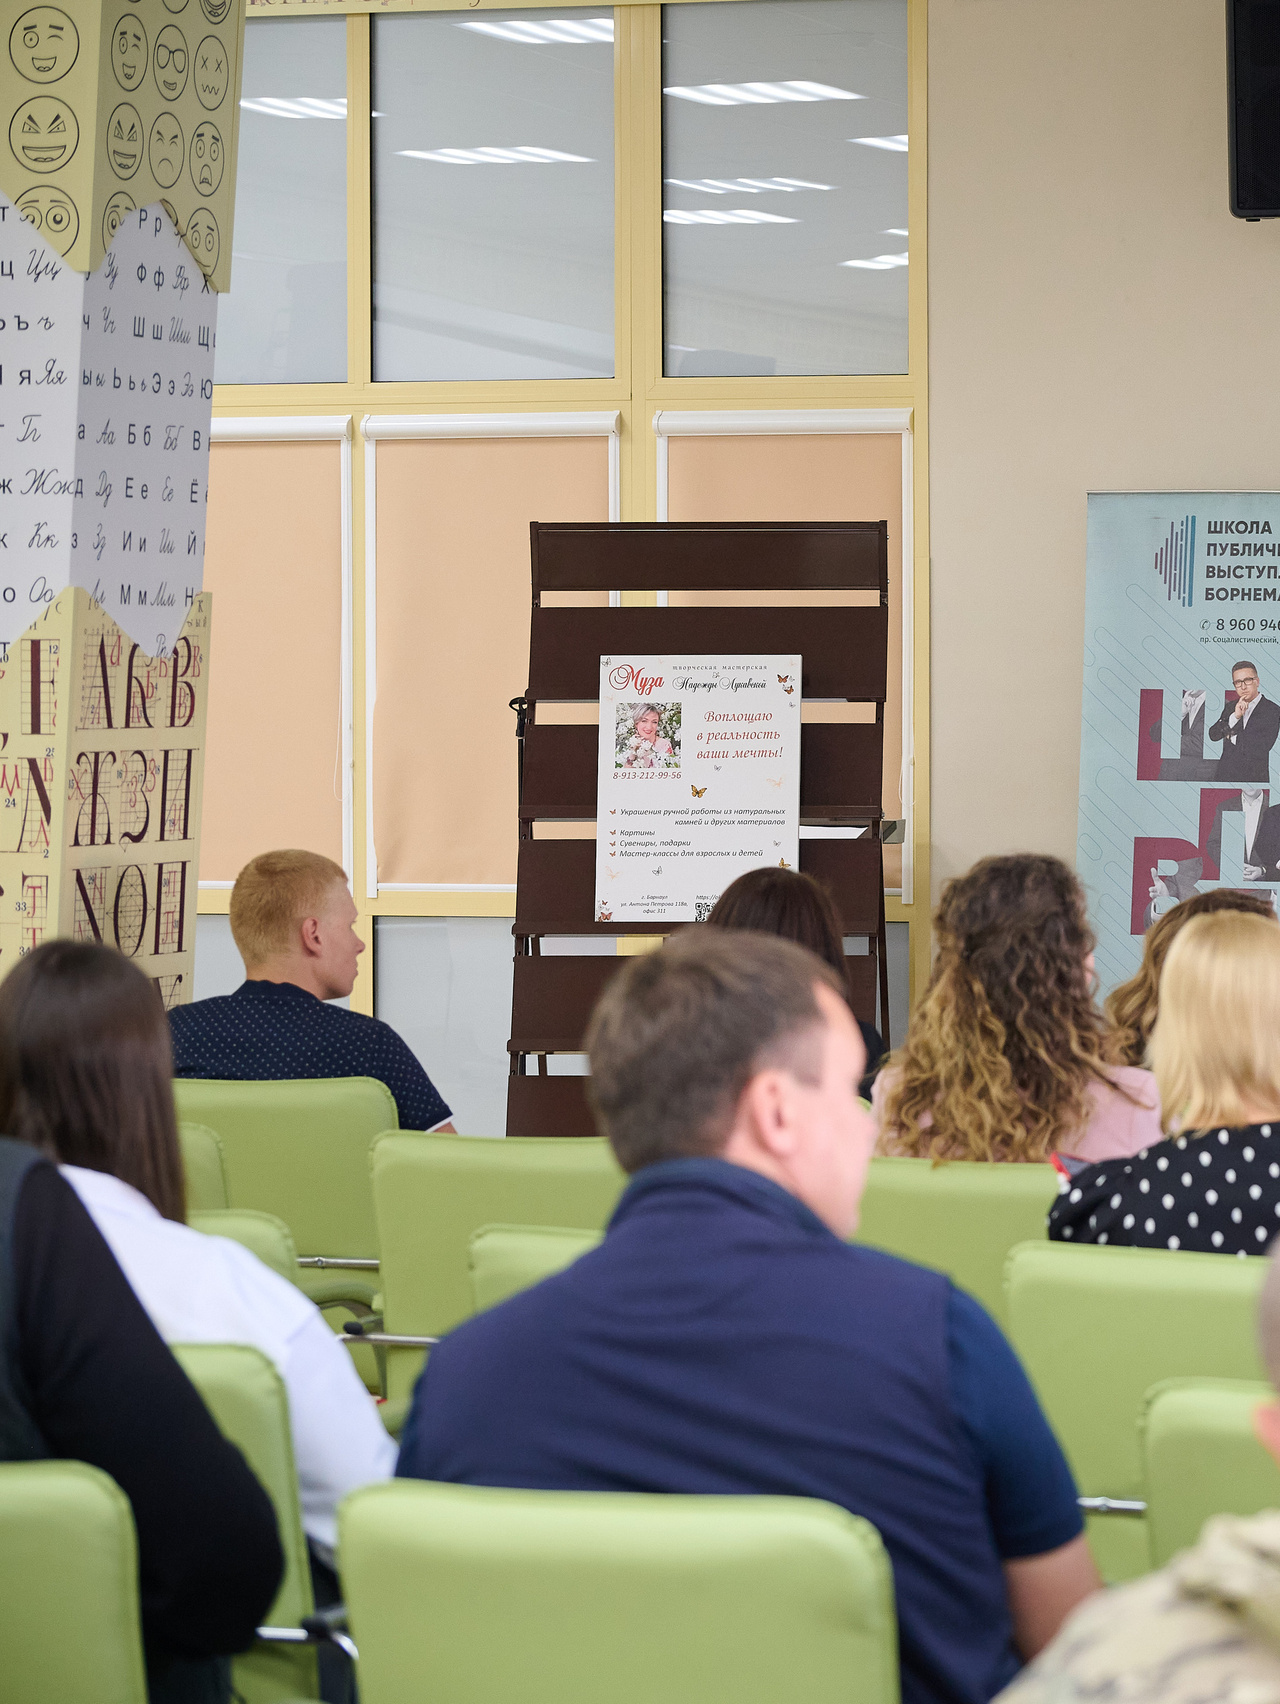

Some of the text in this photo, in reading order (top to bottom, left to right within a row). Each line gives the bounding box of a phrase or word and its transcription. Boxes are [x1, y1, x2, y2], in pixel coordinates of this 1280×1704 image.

[1207, 521, 1272, 535] ШКОЛА
[1216, 618, 1225, 631] 8
[1229, 619, 1255, 631] 960
[609, 664, 665, 696] Муза
[672, 676, 718, 692] Надежды
[704, 711, 773, 724] Воплощаю
[696, 731, 781, 744] в реальность
[696, 747, 783, 760] ваши мечты!
[613, 771, 682, 780] 8-913-212-99-56
[620, 808, 662, 816] Украшения
[663, 807, 690, 817] ручной
[691, 807, 722, 816] работы
[733, 809, 786, 817] натуральных
[675, 818, 703, 826] камней
[710, 819, 736, 827] других
[619, 840, 658, 848] Сувениры,
[619, 850, 679, 858] Мастер-классы
[696, 850, 731, 858] взрослых
[738, 849, 764, 857] детей
